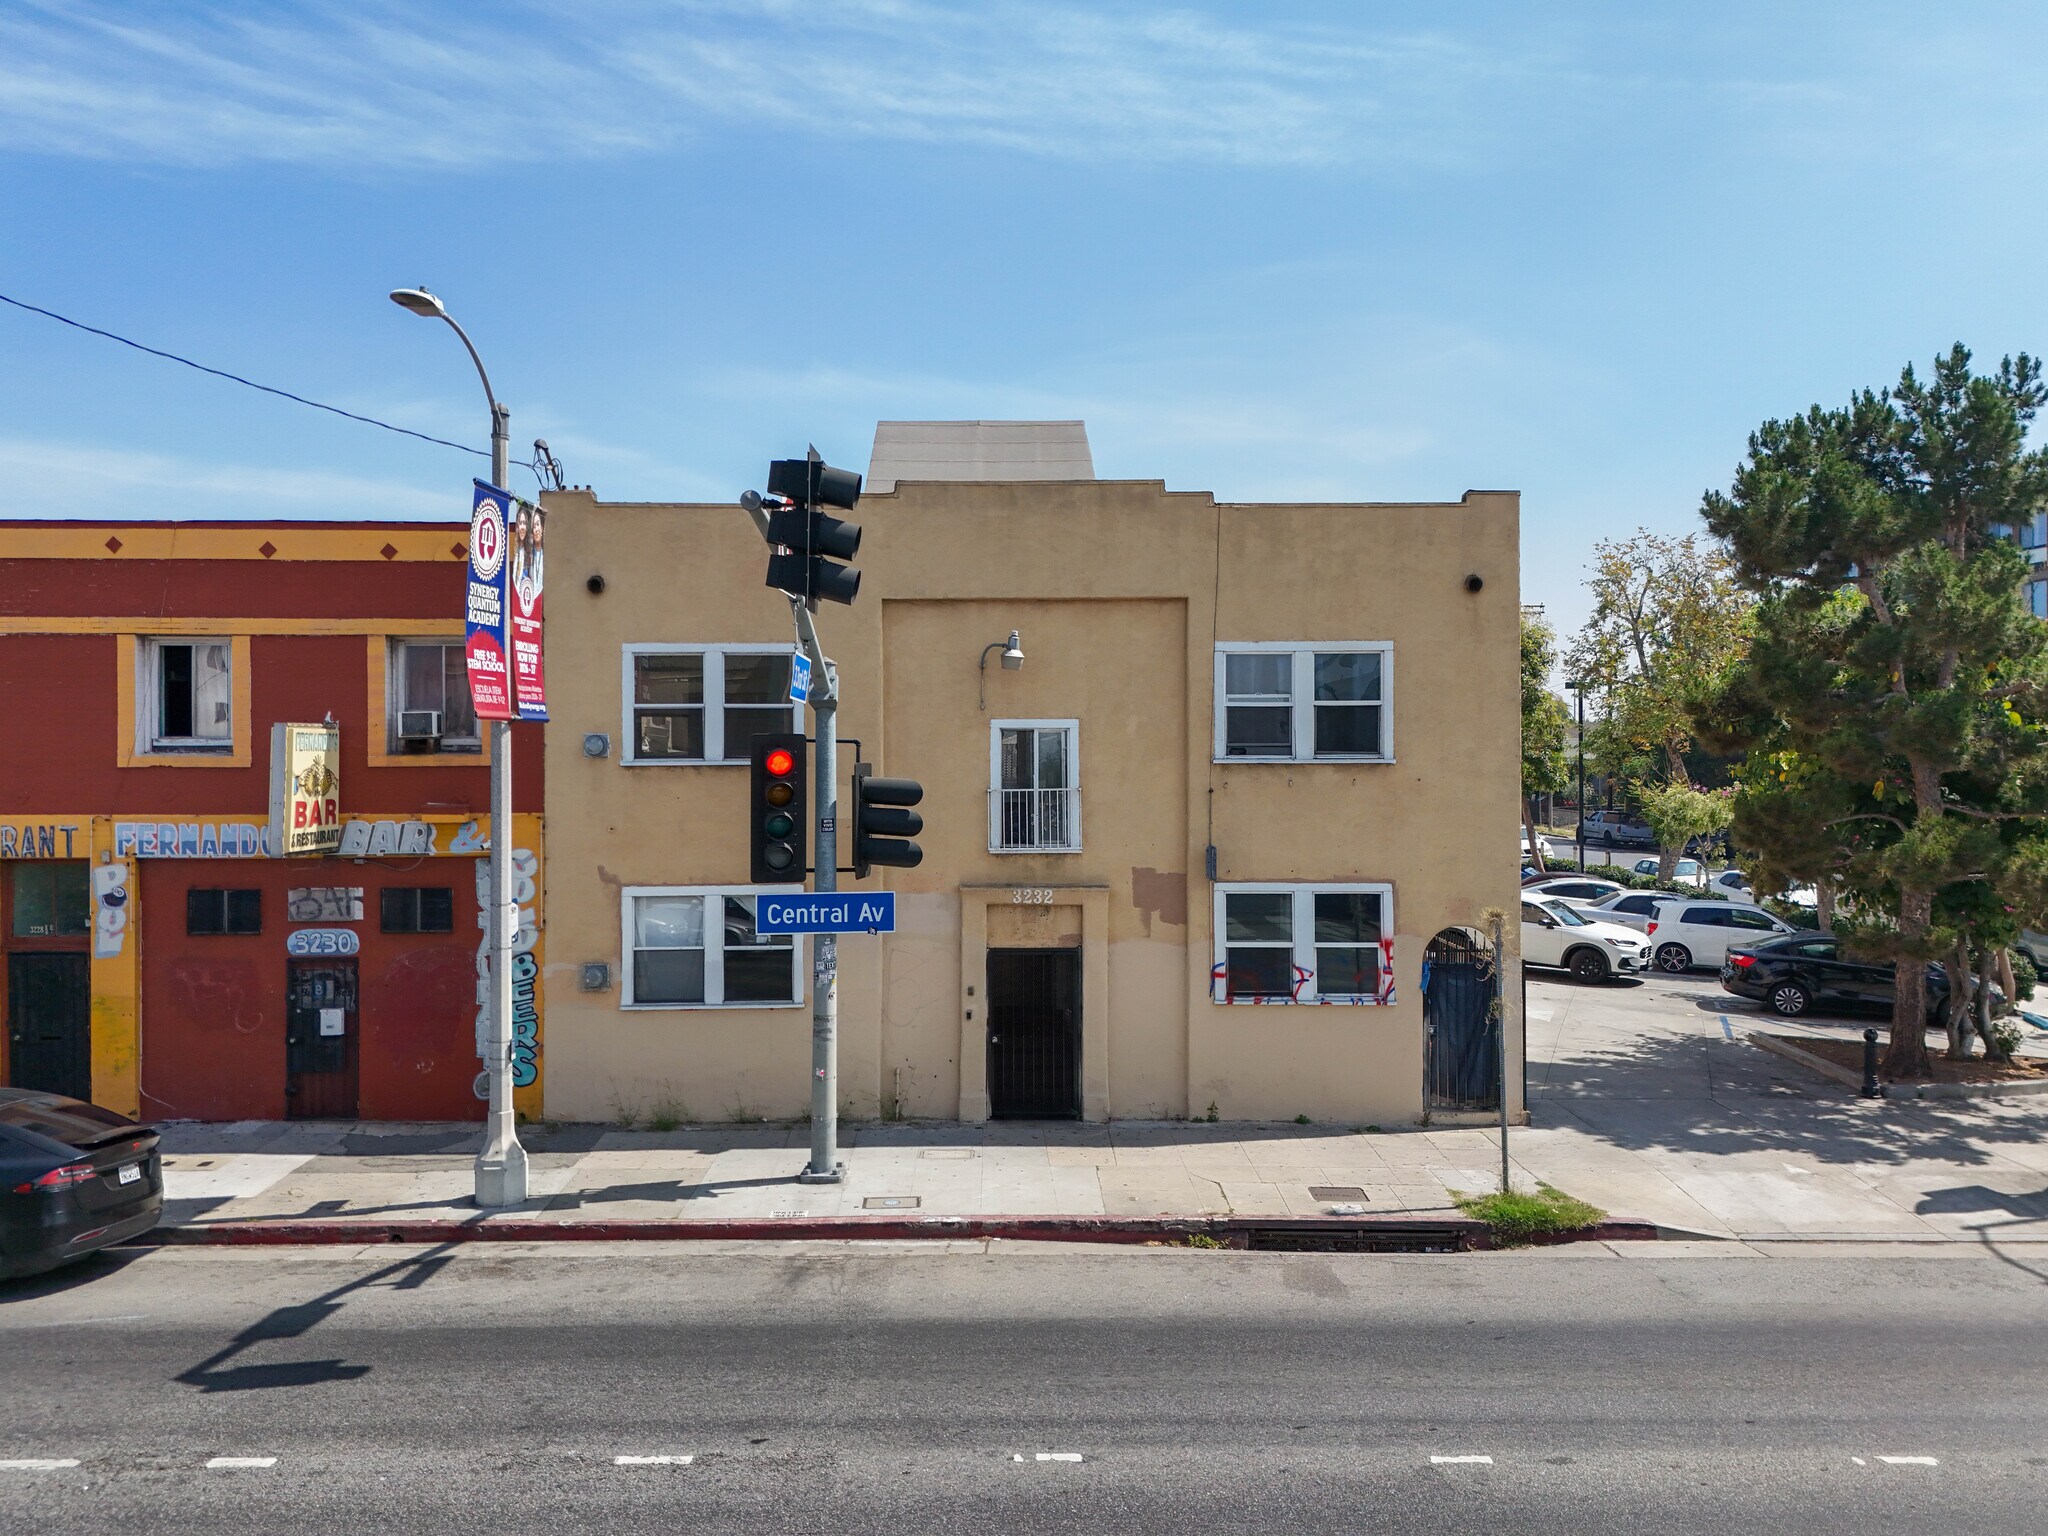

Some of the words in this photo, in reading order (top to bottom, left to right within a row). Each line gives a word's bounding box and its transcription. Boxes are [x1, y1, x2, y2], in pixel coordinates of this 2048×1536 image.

[469, 581, 500, 601] SYNERGY
[467, 595, 500, 614] QUANTUM
[467, 609, 500, 627] ACADEMY
[474, 649, 486, 661] FREE
[515, 639, 539, 654] ENROLLING
[467, 657, 482, 670] STEM
[482, 660, 505, 673] SCHOOL
[517, 651, 528, 663] NOW
[529, 653, 538, 664] FOR
[294, 799, 338, 829] BAR
[296, 829, 340, 848] RESTAURANT
[339, 820, 438, 855] BAR
[1012, 889, 1054, 904] 3232
[767, 903, 849, 925] Central
[858, 902, 885, 923] Av
[295, 932, 352, 954] 3230
